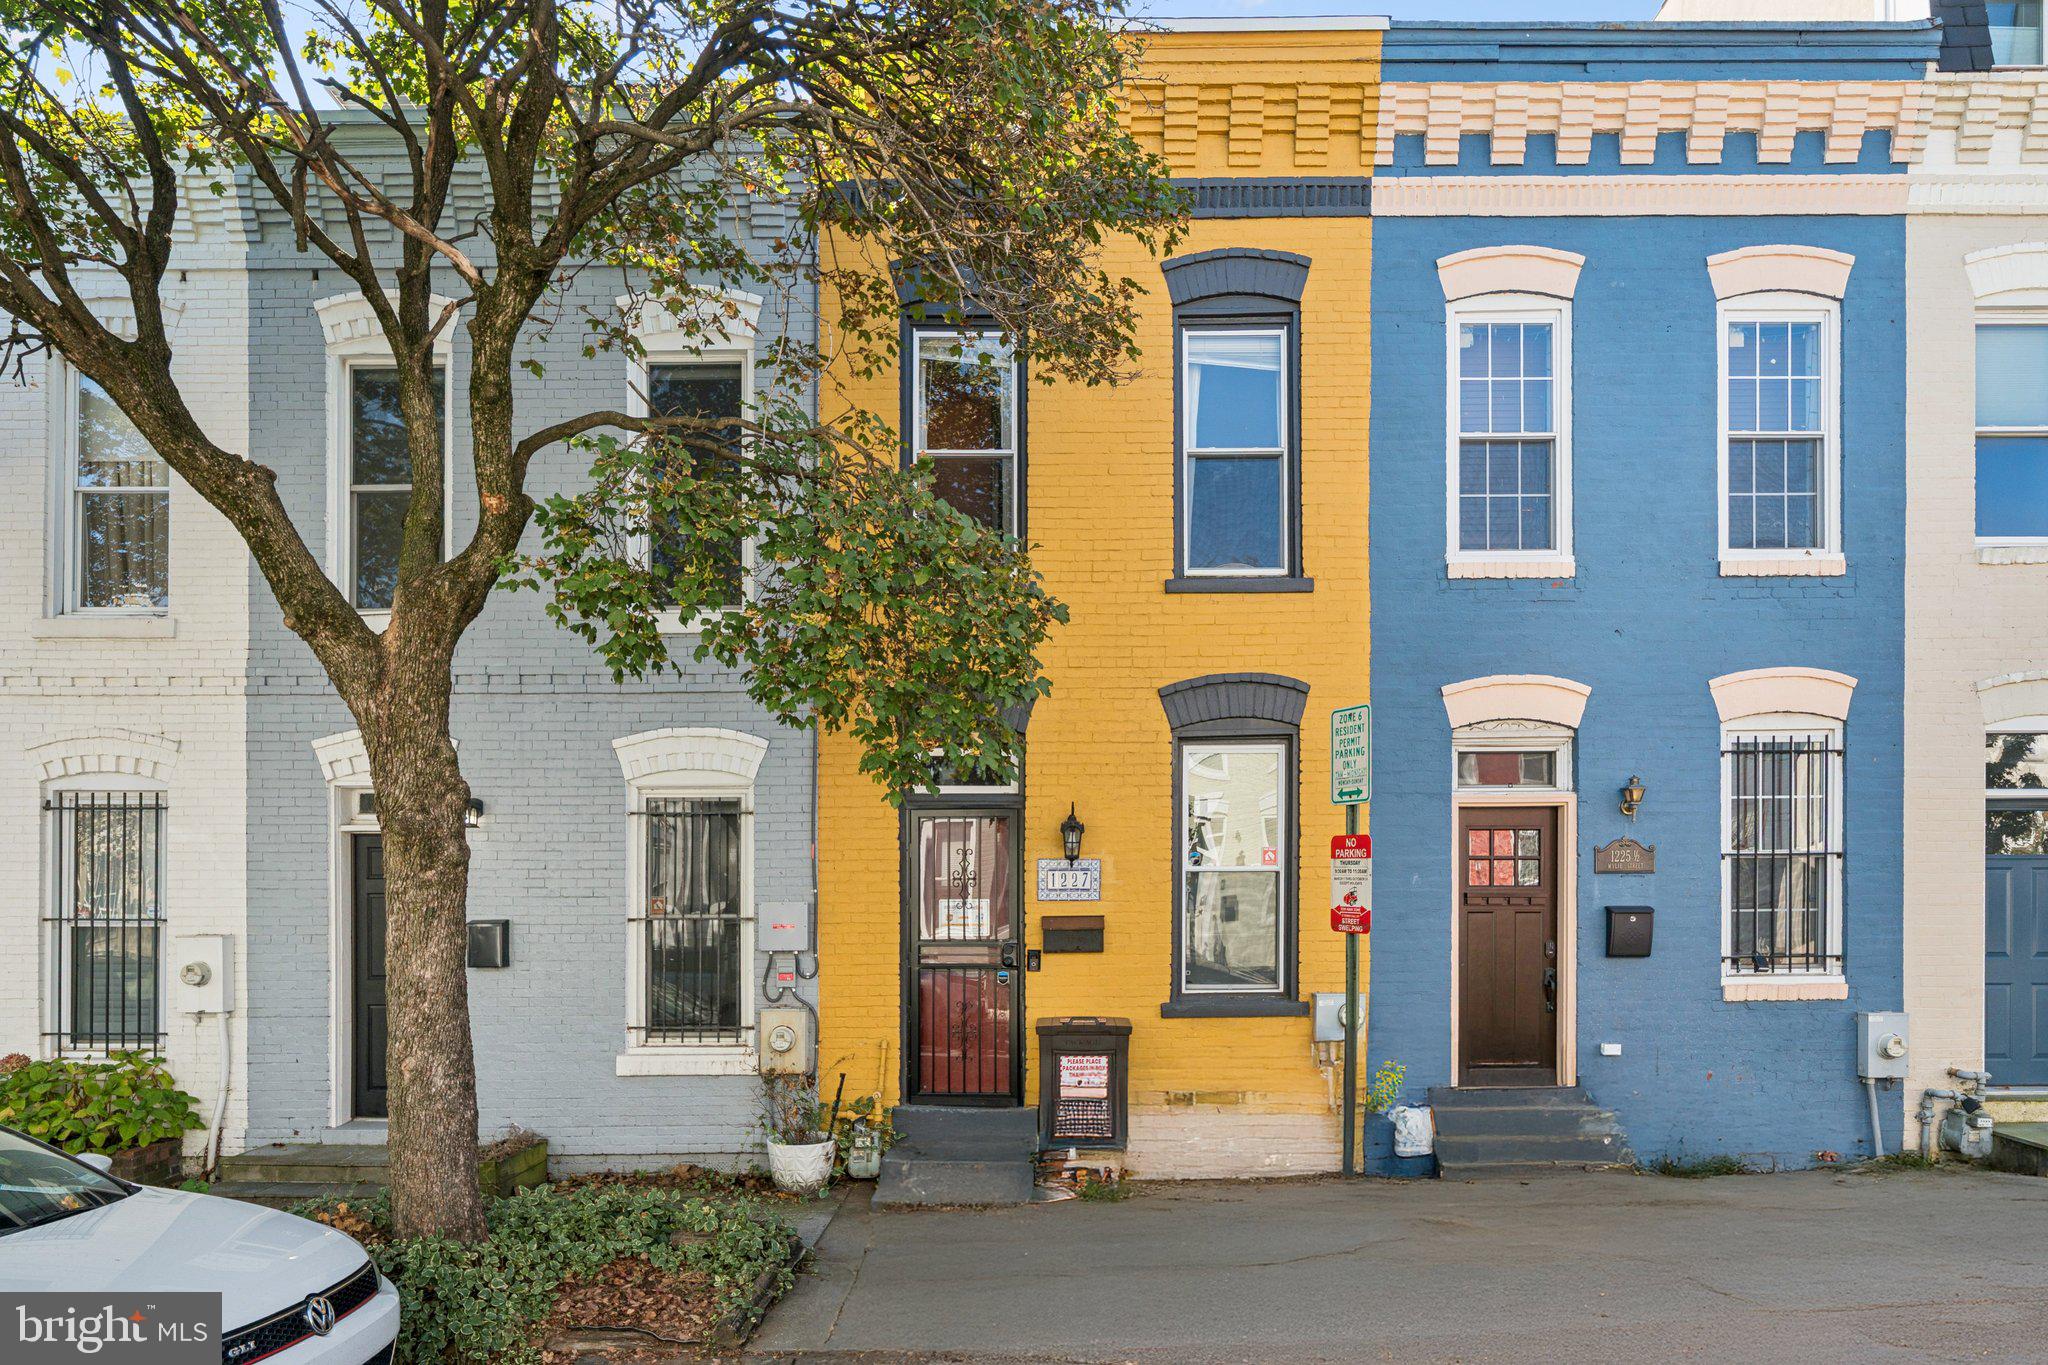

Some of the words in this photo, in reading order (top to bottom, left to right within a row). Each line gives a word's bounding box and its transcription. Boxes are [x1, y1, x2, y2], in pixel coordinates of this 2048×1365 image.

[1339, 712, 1356, 724] ZONE
[1358, 711, 1363, 721] 6
[1335, 723, 1365, 737] RESIDENT
[1339, 736, 1361, 748] PERMIT
[1335, 746, 1365, 759] PARKING
[1342, 759, 1357, 770] ONLY
[1345, 837, 1357, 847] NO
[1335, 849, 1367, 858] PARKING
[1611, 850, 1631, 862] 1225
[1051, 873, 1088, 887] 1227
